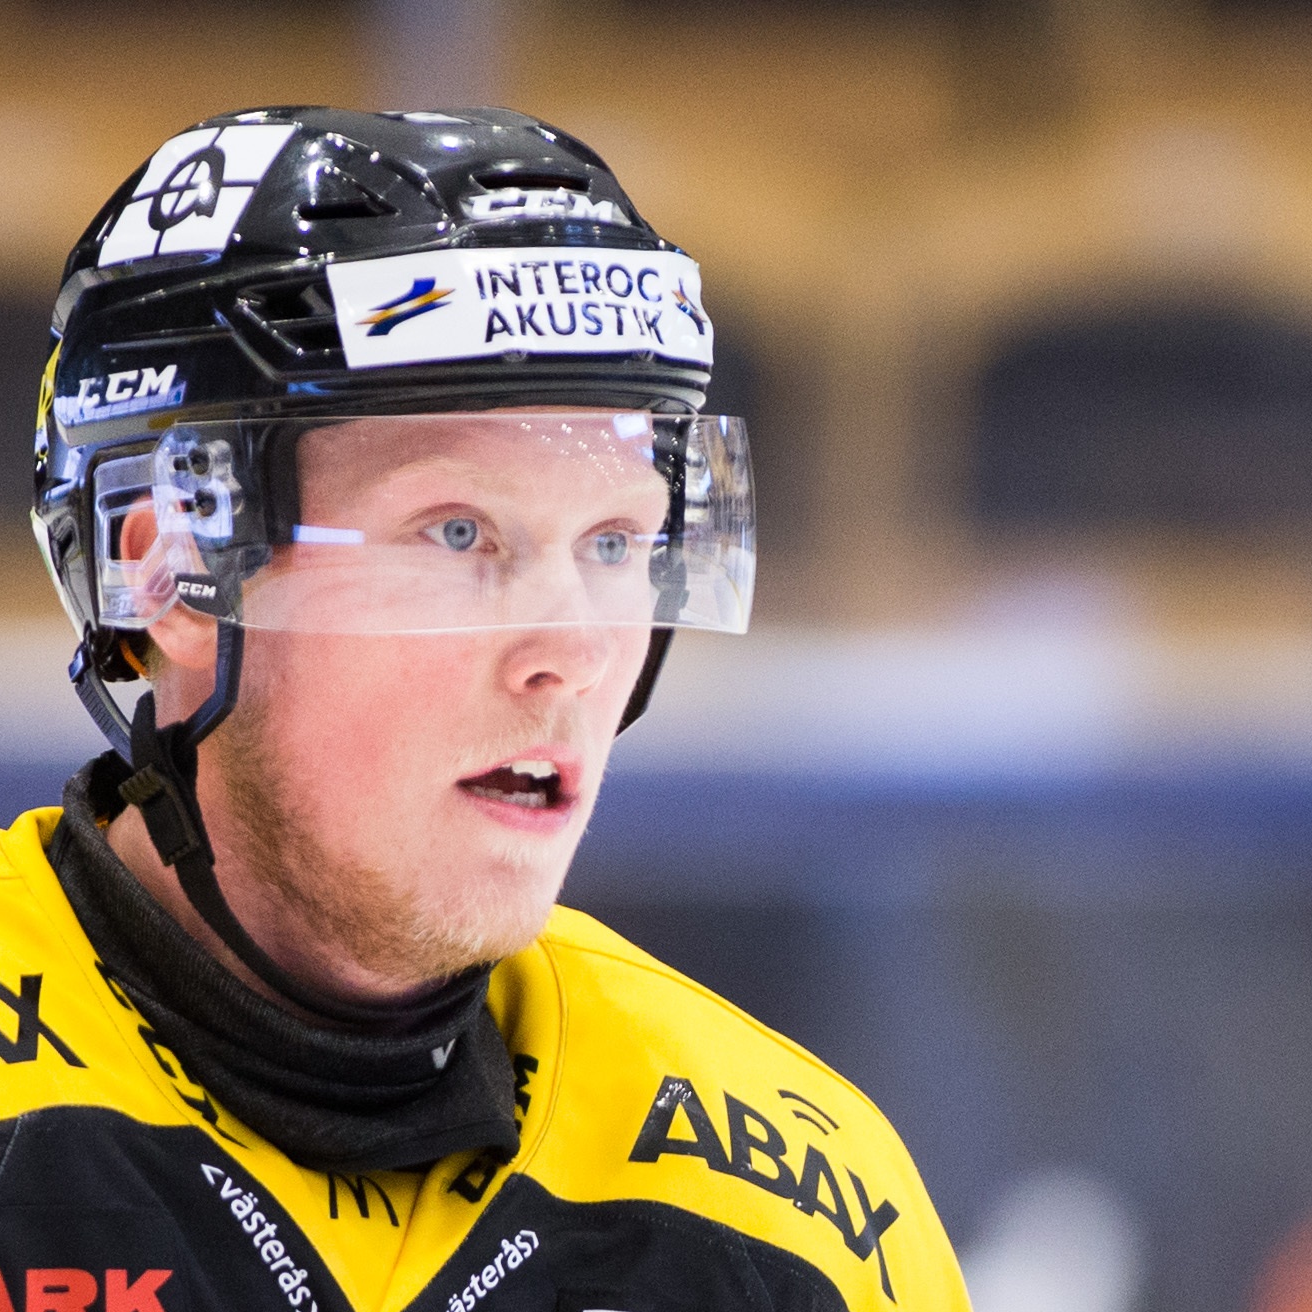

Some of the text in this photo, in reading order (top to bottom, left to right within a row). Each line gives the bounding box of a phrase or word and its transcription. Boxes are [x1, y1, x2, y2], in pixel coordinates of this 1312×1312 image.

[468, 188, 613, 223] CCM
[474, 259, 664, 303] INTEROC
[484, 300, 666, 346] AKUSTIK
[77, 364, 178, 410] CCM
[177, 580, 217, 600] CCM
[628, 1074, 900, 1306] ABAX
